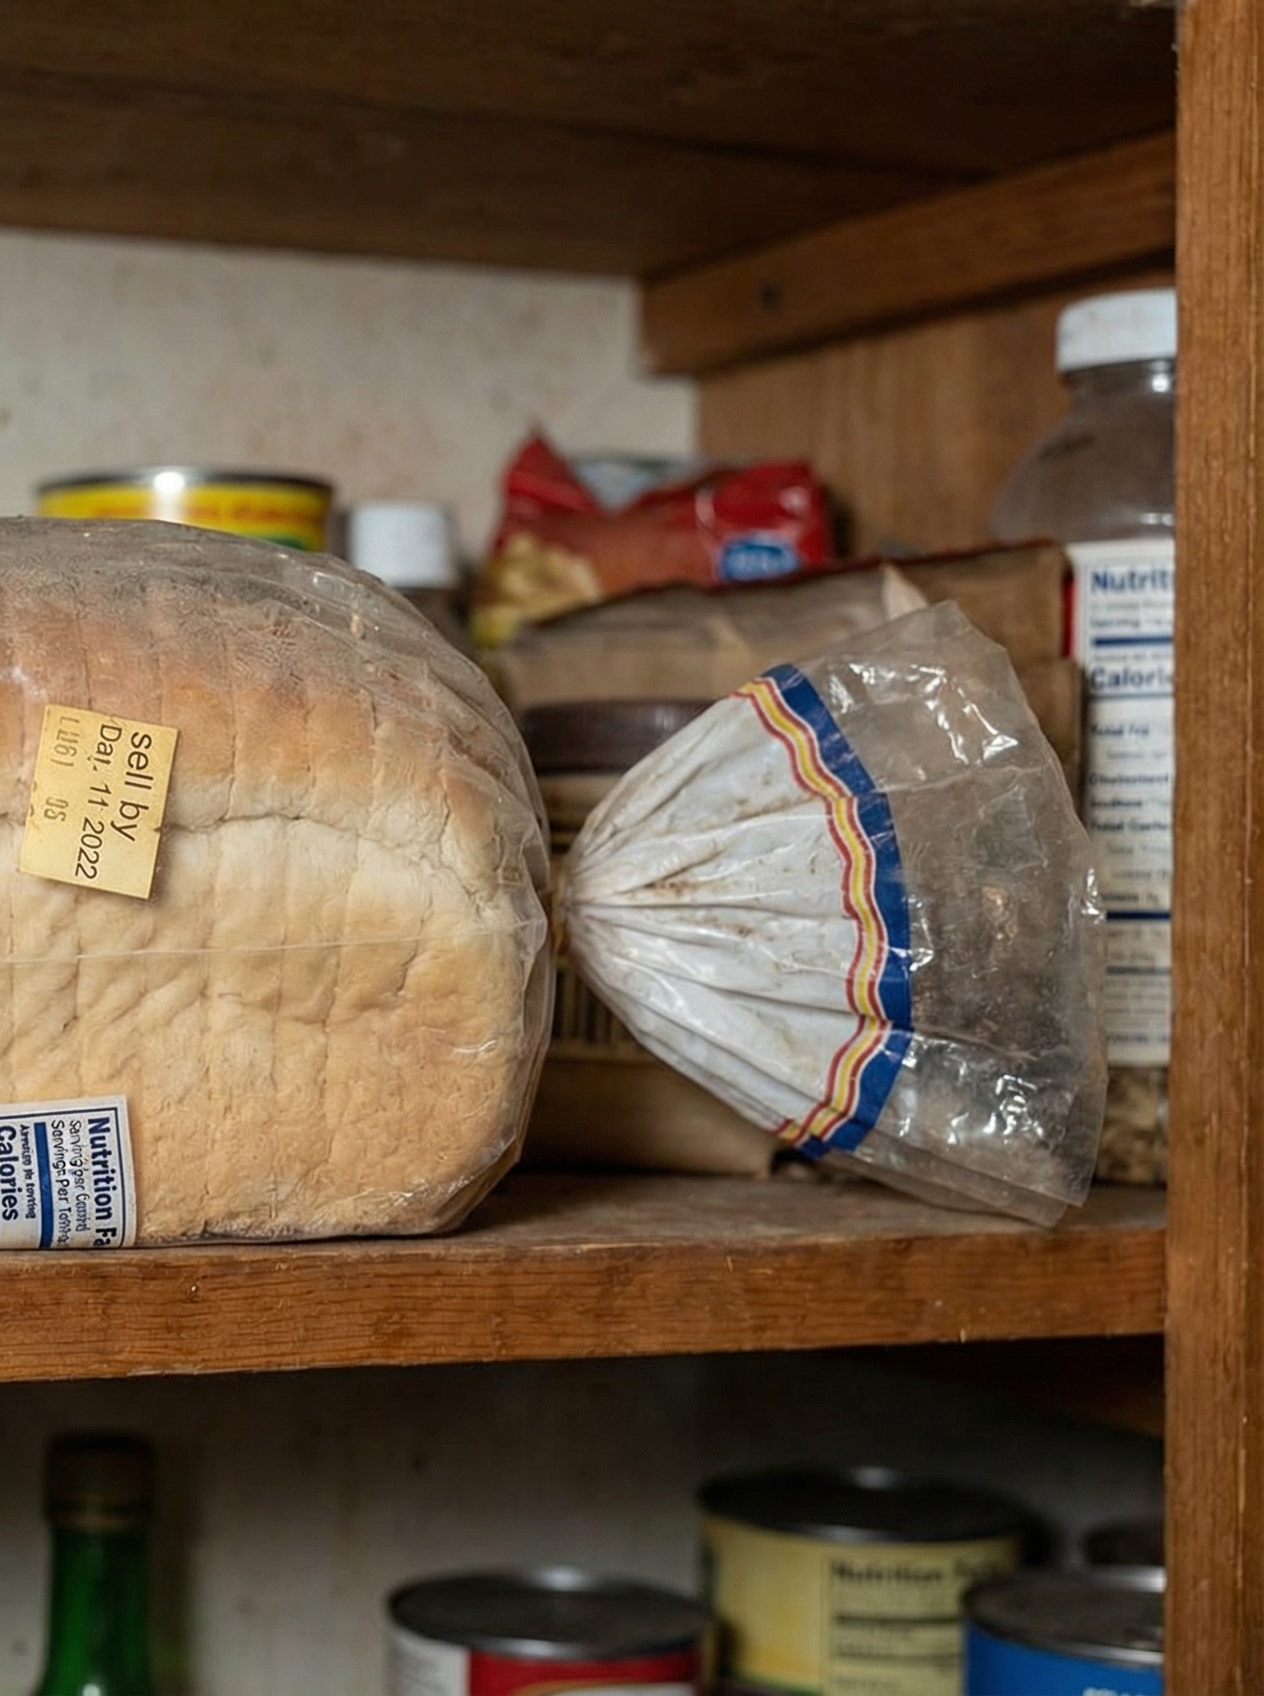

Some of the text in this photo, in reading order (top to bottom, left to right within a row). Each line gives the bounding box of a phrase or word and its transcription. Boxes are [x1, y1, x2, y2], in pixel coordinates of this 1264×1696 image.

[110, 731, 154, 842] sell by
[74, 816, 106, 880] 2022
[88, 1116, 118, 1221] Nutrition
